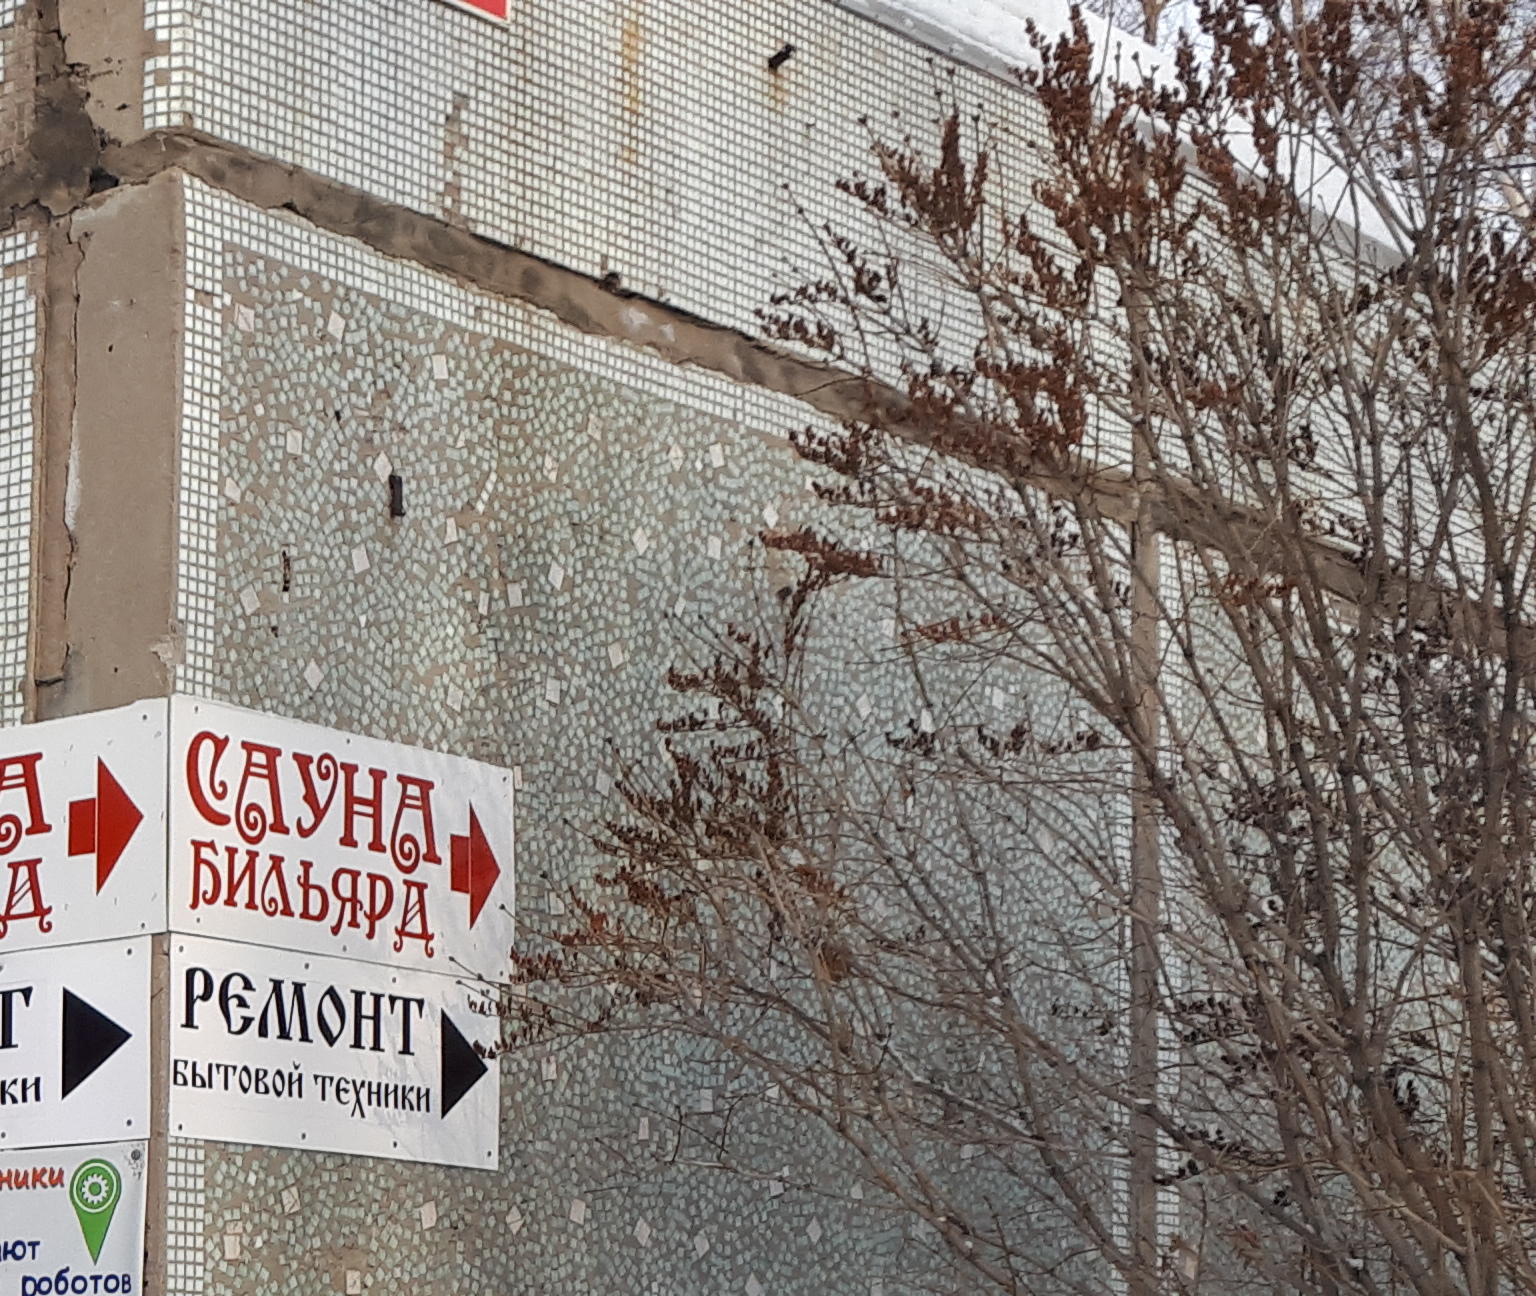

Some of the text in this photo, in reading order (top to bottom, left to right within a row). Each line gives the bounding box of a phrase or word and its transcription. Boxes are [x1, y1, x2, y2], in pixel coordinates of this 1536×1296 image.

[186, 730, 443, 875] САУНА
[188, 839, 437, 958] БИЛЬЯРД
[181, 967, 425, 1057] РЕМОНТ
[172, 1058, 433, 1118] БЫТОВОЙ ТЕХНИКИ
